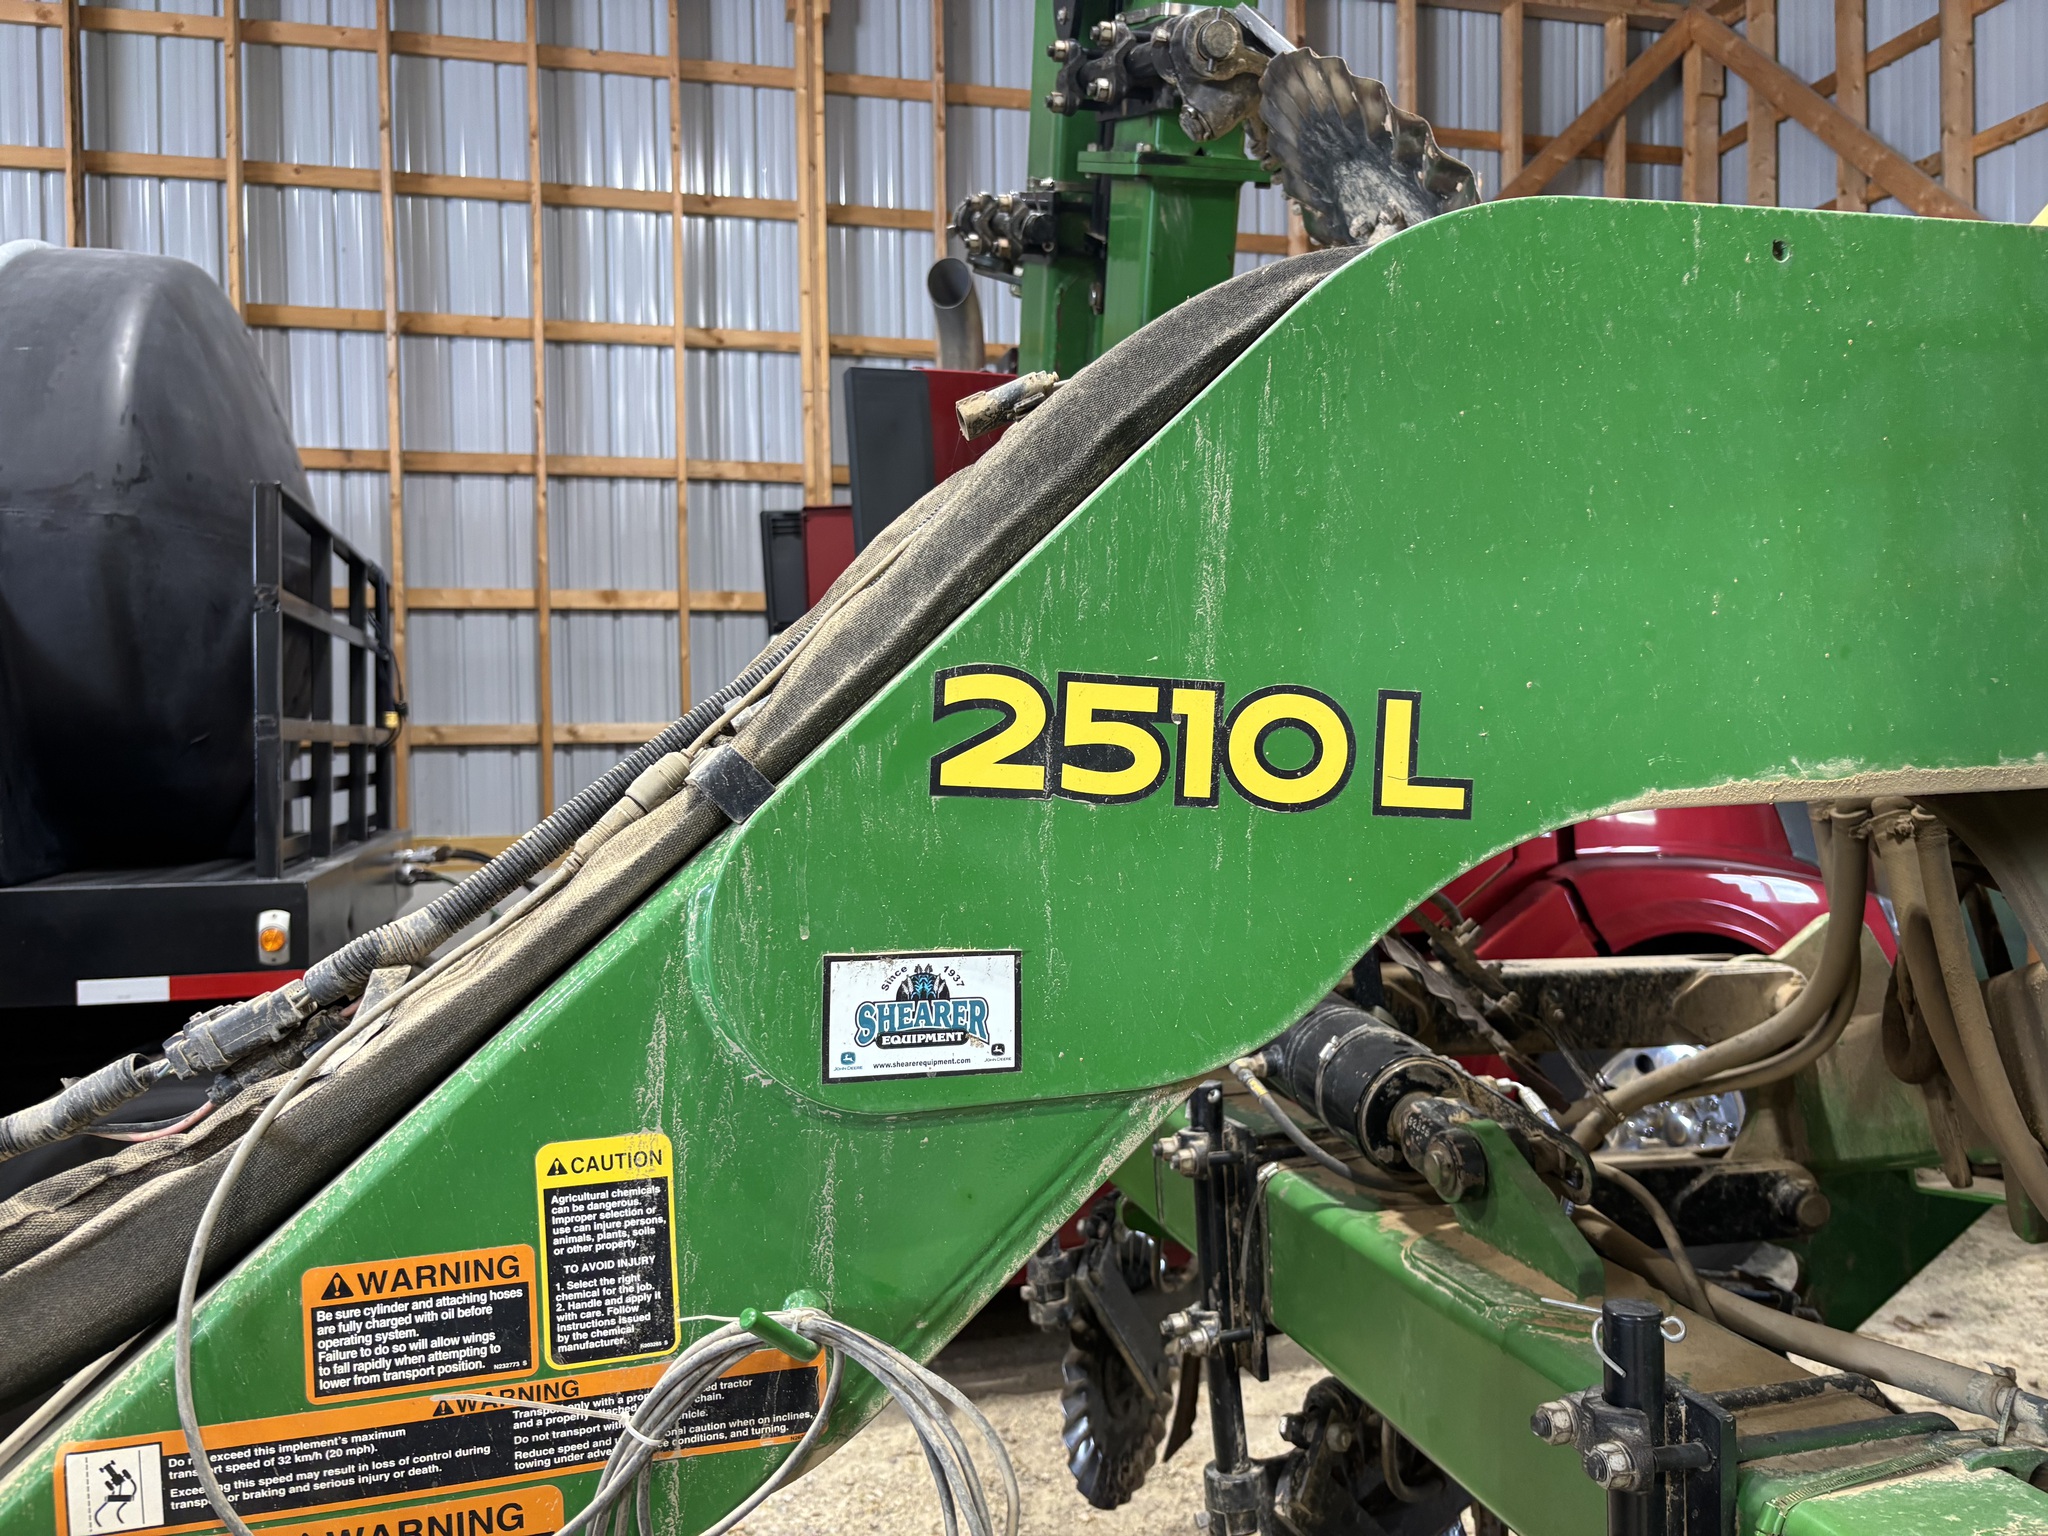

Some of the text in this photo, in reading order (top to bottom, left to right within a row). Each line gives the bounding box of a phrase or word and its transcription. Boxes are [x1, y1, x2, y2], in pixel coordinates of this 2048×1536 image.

[930, 664, 1473, 819] 2510 L
[881, 965, 965, 991] Since 1937
[856, 999, 989, 1046] SHEARER
[882, 1031, 964, 1046] EQUIPMENT
[873, 1057, 971, 1069] www.shearerequipment.com
[571, 1150, 663, 1175] CAUTION
[551, 1185, 661, 1205] Agricultural chemicals
[551, 1196, 642, 1214] can be dangerous.
[552, 1206, 657, 1225] Improper selection or
[552, 1216, 666, 1235] use can injure persons,
[552, 1226, 655, 1245] animals, plants, soils
[566, 1244, 593, 1254] other
[595, 1238, 639, 1252] property.
[357, 1255, 520, 1295] WARNING
[563, 1255, 655, 1274] TO AVOID INJURY
[555, 1272, 640, 1291] 1. Select the right
[555, 1282, 656, 1301] chemical for the job.
[316, 1288, 523, 1322] Be sure cylinder and attaching hoses
[556, 1291, 661, 1312] 2. Handle and apply it
[556, 1302, 639, 1322] with care. Follow
[317, 1304, 492, 1335] are fully charged with oil before
[557, 1312, 651, 1332] instructions issued
[317, 1328, 420, 1351] operating system.
[318, 1329, 495, 1362] Failure to do so will allow wings
[557, 1324, 635, 1344] by the chemical
[557, 1335, 626, 1352] manufacturer.
[318, 1343, 501, 1376] to fall rapidly when attempting to
[319, 1356, 485, 1390] lower from transport position.
[592, 1397, 614, 1407] with
[720, 1379, 752, 1389] tractor
[513, 1418, 533, 1429] and
[693, 1392, 724, 1402] chain.
[514, 1436, 529, 1444] Do
[532, 1432, 549, 1441] not
[551, 1424, 600, 1438] transport
[514, 1447, 554, 1460] Reduce
[557, 1440, 589, 1454] speed
[592, 1437, 611, 1447] and
[689, 1422, 726, 1433] caution
[728, 1419, 754, 1427] when
[773, 1411, 813, 1422] inclines,
[168, 1458, 185, 1467] Do
[209, 1448, 251, 1462] exceed
[254, 1446, 275, 1456] this
[278, 1436, 348, 1453] implement's
[351, 1429, 405, 1443] maximum
[514, 1458, 550, 1470] towing
[553, 1452, 584, 1463] under
[672, 1432, 727, 1447] conditions,
[730, 1428, 748, 1438] and
[751, 1424, 788, 1436] turning.
[168, 1443, 377, 1479] transrt speed of 32 km/h (20 mph).
[170, 1446, 490, 1497] Exceeng this speed may result in loss of control during
[227, 1494, 239, 1503] or
[242, 1488, 285, 1500] braking
[288, 1482, 310, 1493] and
[313, 1478, 355, 1490] serious
[358, 1473, 390, 1484] injury
[393, 1470, 405, 1478] or
[408, 1464, 442, 1476] death.
